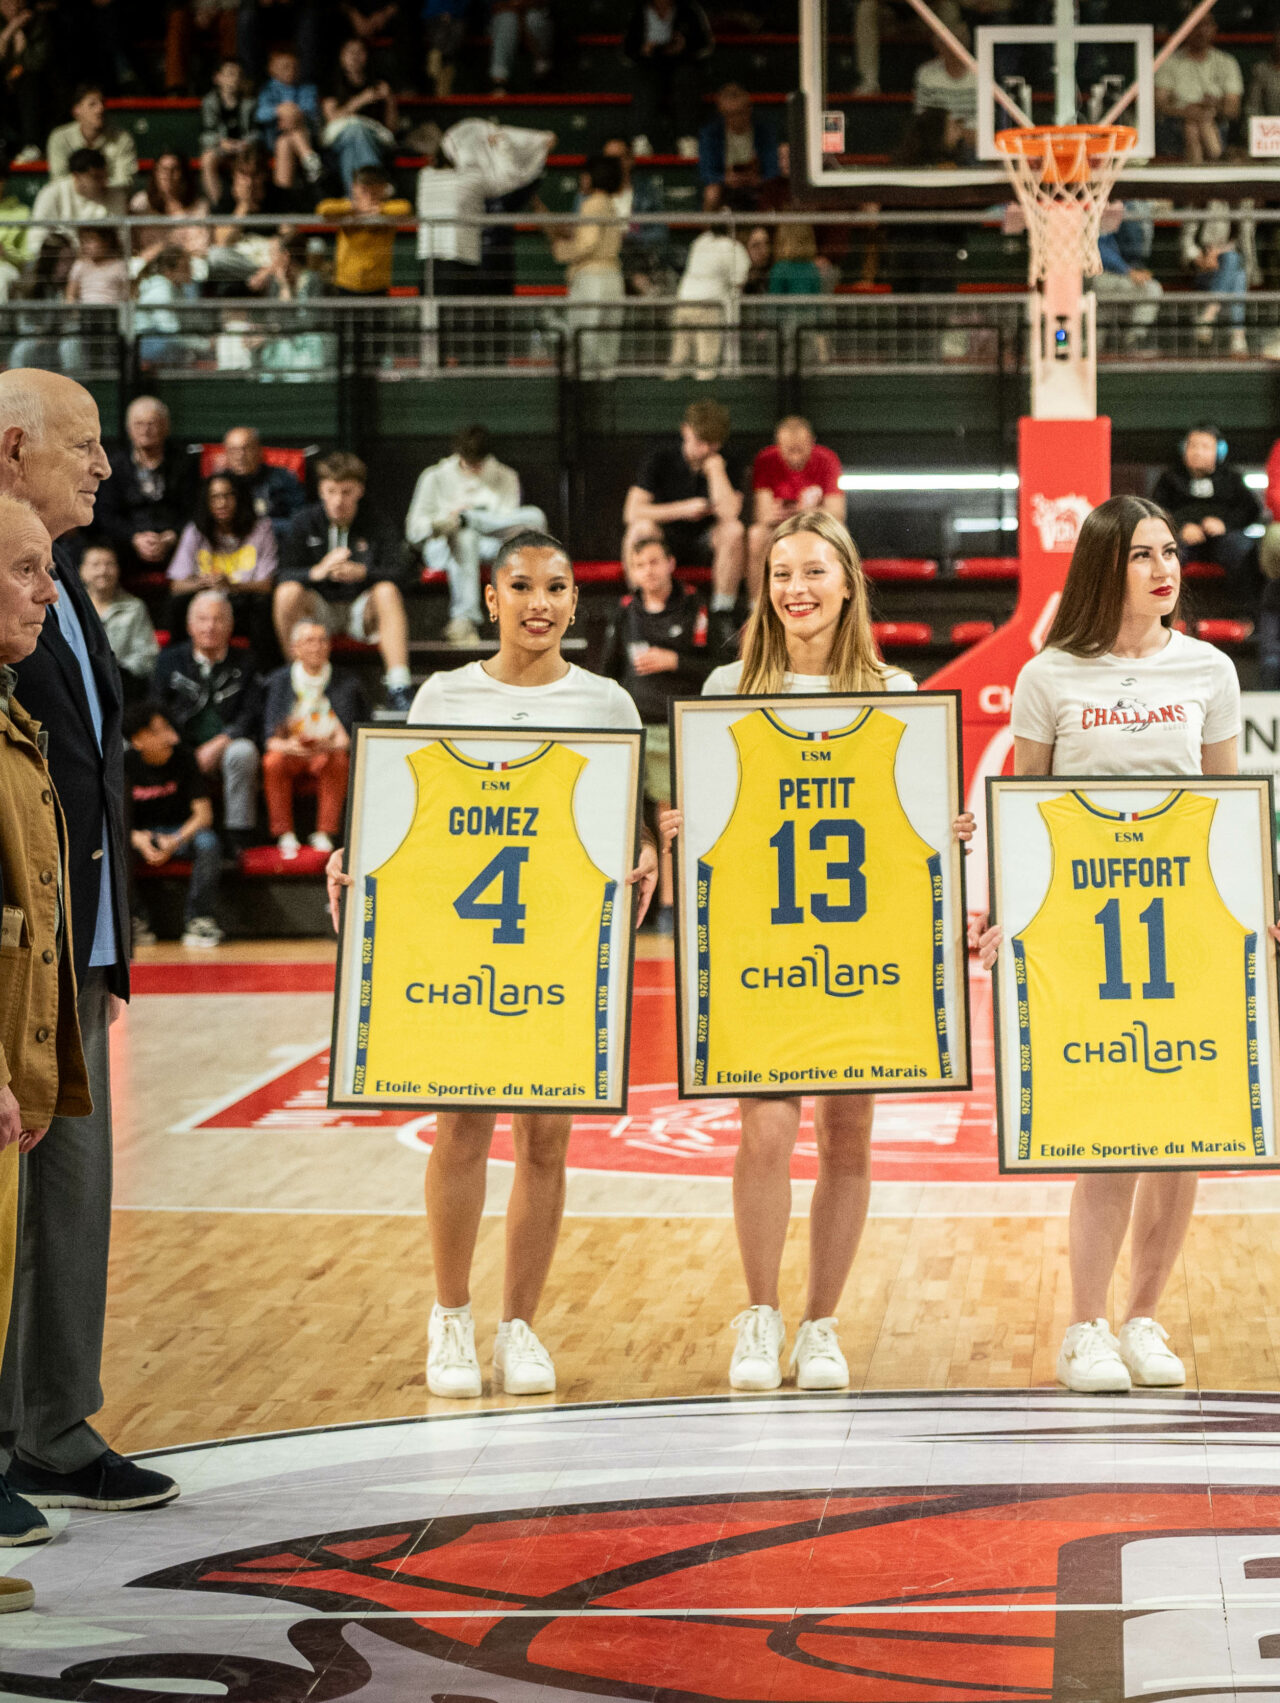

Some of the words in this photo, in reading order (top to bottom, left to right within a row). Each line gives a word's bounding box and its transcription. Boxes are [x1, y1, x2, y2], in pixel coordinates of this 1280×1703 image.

[1081, 704, 1188, 731] CHALLANS
[801, 751, 832, 761] ESM
[481, 780, 511, 791] ESM
[779, 776, 856, 810] PETIT
[448, 805, 539, 837] GOMEZ
[1114, 832, 1144, 843] ESM
[769, 818, 867, 925] 13
[1071, 856, 1191, 890] DUFFORT
[452, 845, 530, 945] 4
[697, 880, 708, 908] 2026
[932, 875, 943, 902] 1936
[364, 895, 373, 922] 2026
[602, 901, 613, 927] 1936
[698, 924, 708, 952] 2026
[935, 919, 944, 946] 1936
[362, 937, 373, 964] 2026
[600, 943, 610, 969] 1936
[1094, 897, 1175, 1000] 11
[935, 963, 944, 990] 1936
[1014, 957, 1027, 984] 2026
[1248, 953, 1256, 979] 1936
[361, 979, 370, 1007] 2026
[699, 969, 709, 998] 2026
[598, 985, 608, 1011] 1936
[1248, 996, 1257, 1022] 1936
[698, 1014, 708, 1042] 2026
[938, 1008, 947, 1035] 1936
[1018, 1000, 1029, 1029] 2026
[358, 1022, 369, 1049] 2026
[598, 1028, 608, 1053] 1936
[1020, 1044, 1031, 1072] 2026
[1250, 1039, 1258, 1066] 1936
[354, 1064, 366, 1092] 2026
[693, 1058, 705, 1086] 2026
[716, 1070, 762, 1084] Etoile
[768, 1066, 838, 1084] Sportive
[843, 1065, 864, 1078] du
[871, 1065, 928, 1078] Marais
[375, 1080, 421, 1093] Etoile
[428, 1083, 496, 1097] Sportive
[502, 1083, 523, 1096] du
[530, 1083, 586, 1097] Marais
[1021, 1087, 1031, 1115] 2026
[1251, 1083, 1260, 1110] 1936
[1019, 1130, 1030, 1158] 2026
[1040, 1144, 1085, 1157] Etoile
[1091, 1143, 1158, 1158] Sportive
[1164, 1142, 1185, 1154] du
[1191, 1140, 1246, 1153] Marais
